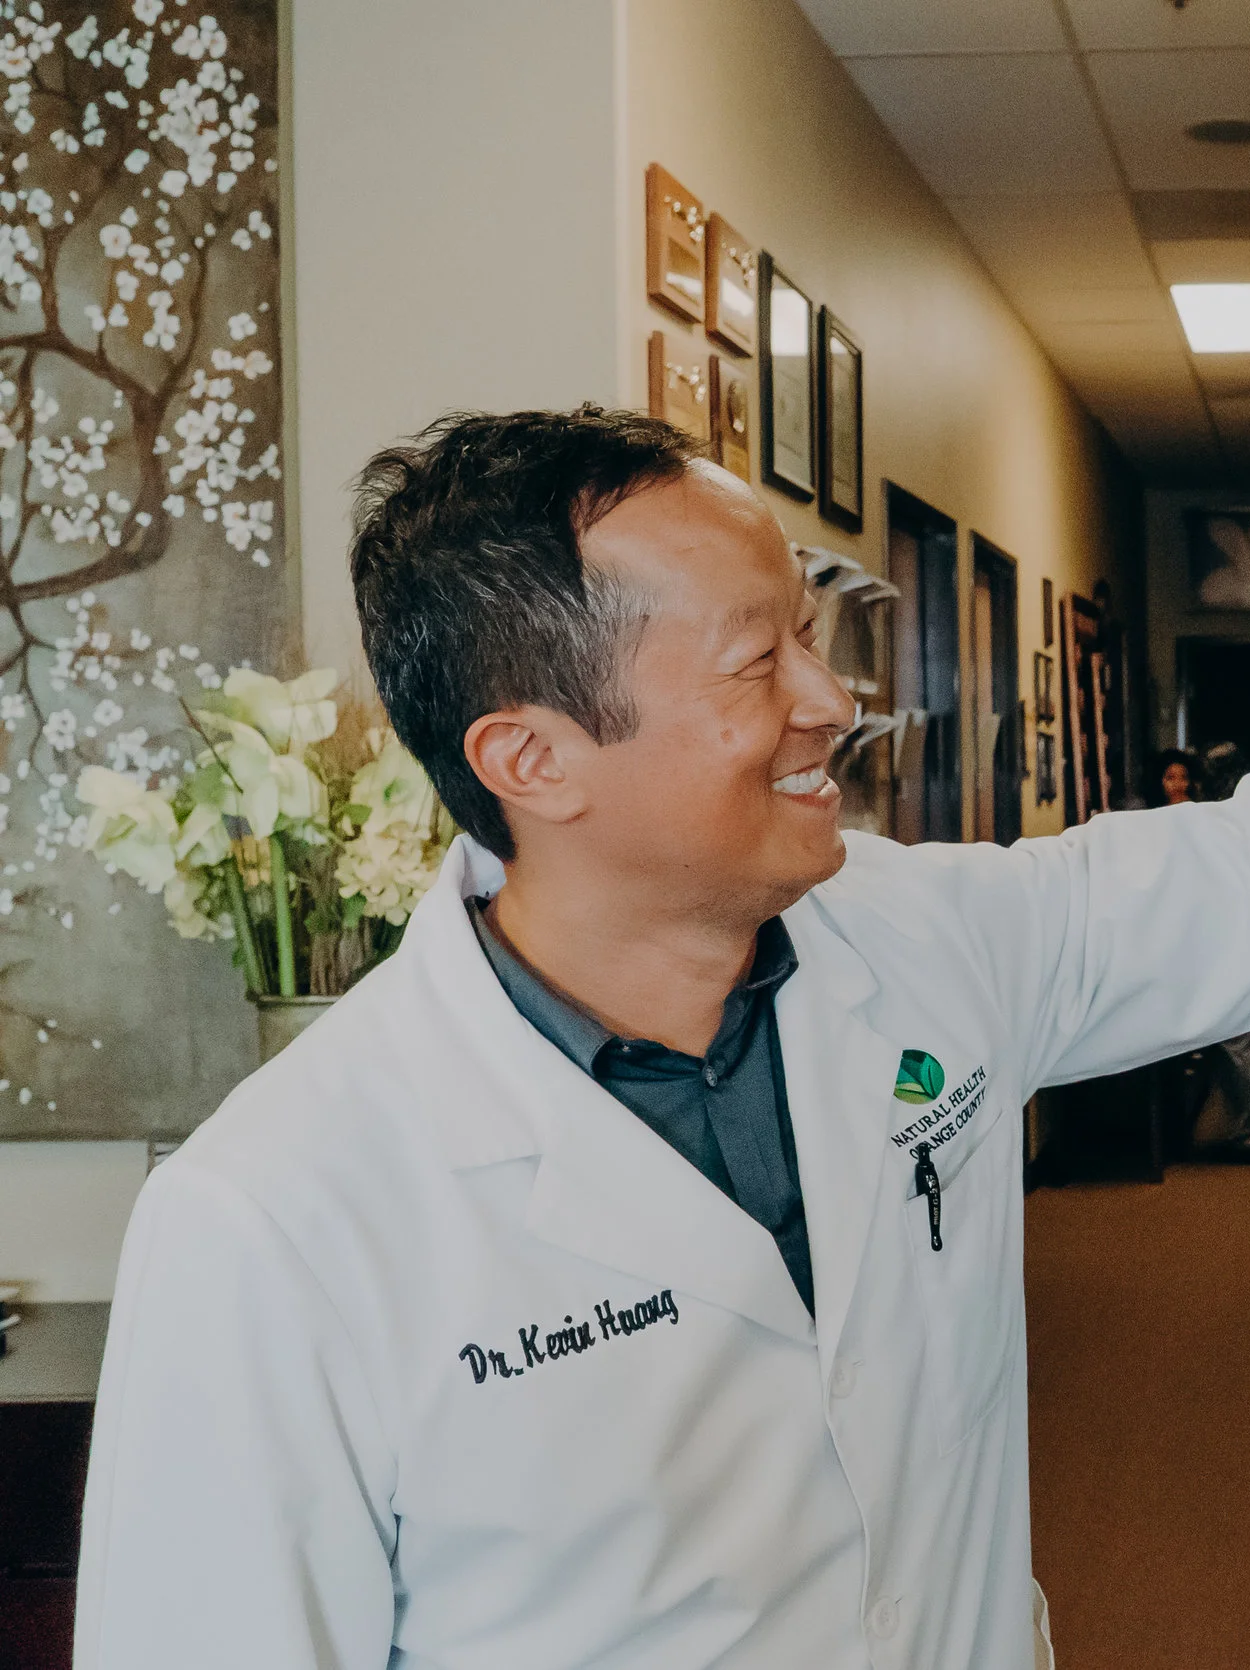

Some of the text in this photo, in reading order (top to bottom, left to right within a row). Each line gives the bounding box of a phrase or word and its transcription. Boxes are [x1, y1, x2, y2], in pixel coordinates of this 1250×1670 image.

[891, 1066, 986, 1147] NATURAL HEALTH
[909, 1086, 986, 1160] OANGE COUNTY
[459, 1290, 679, 1384] Dr. Kevin Huang
